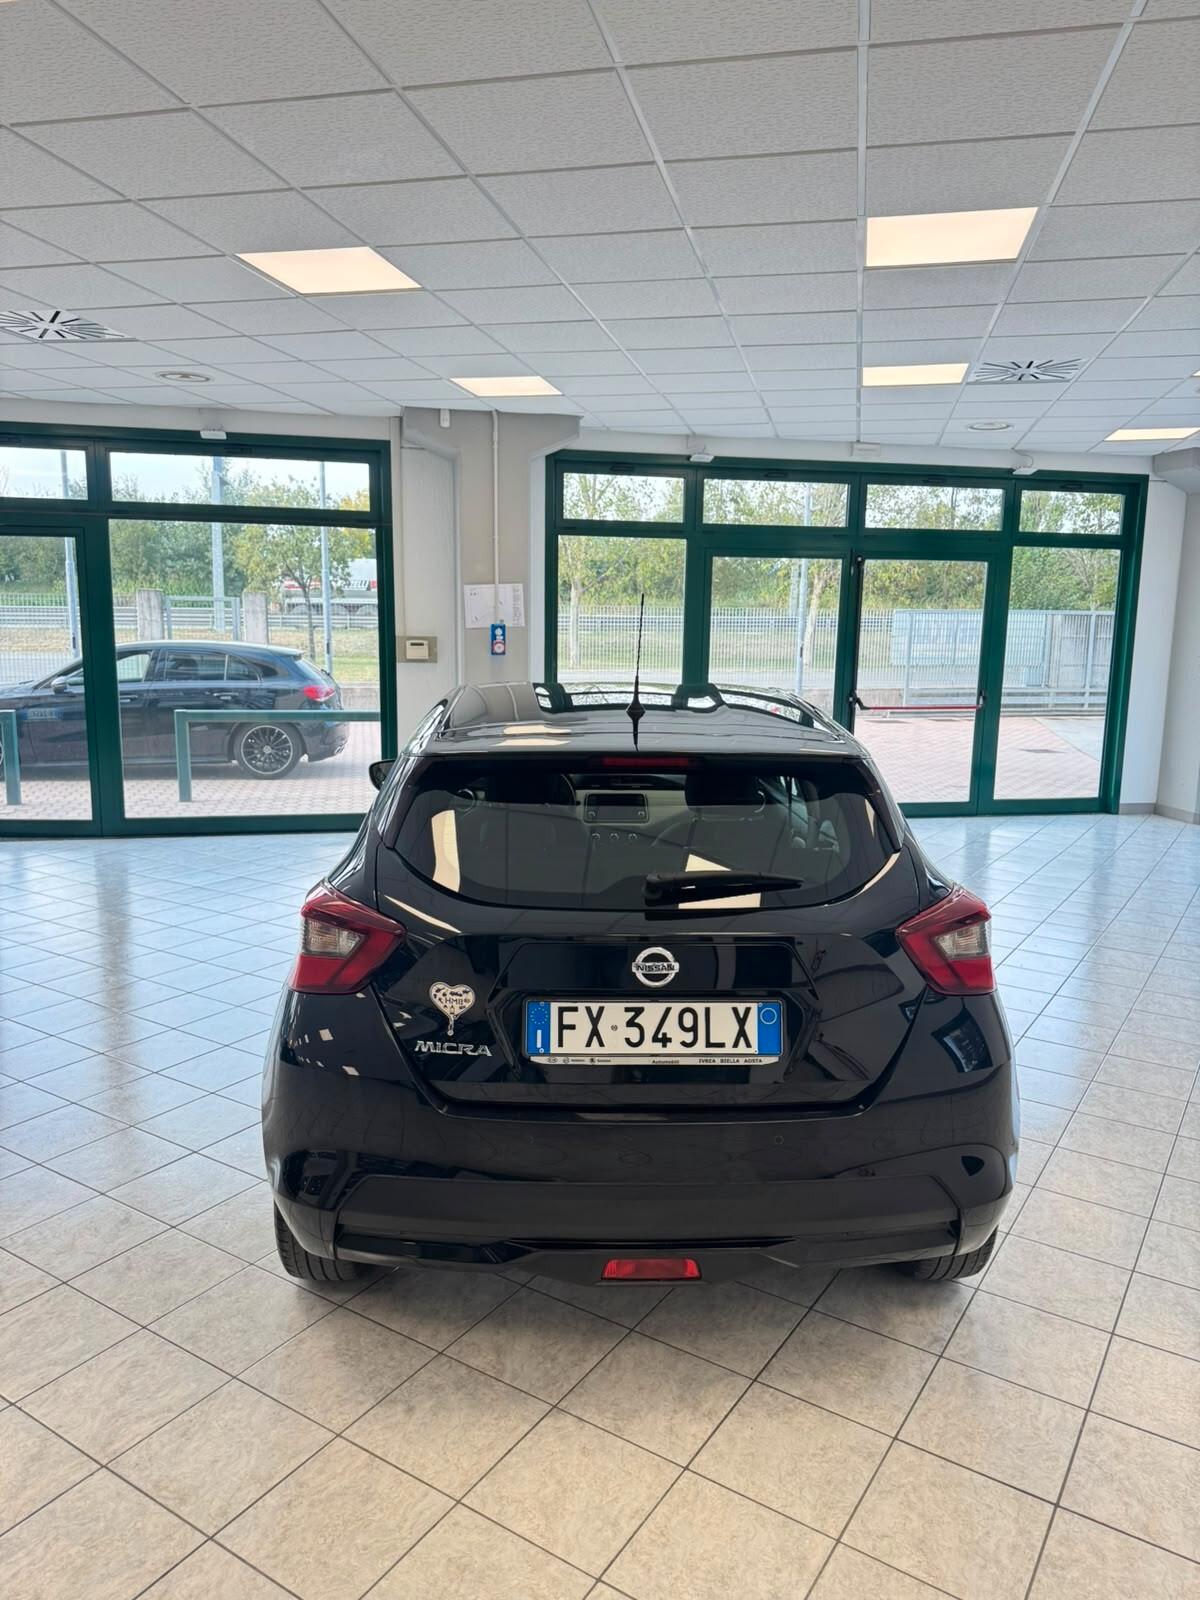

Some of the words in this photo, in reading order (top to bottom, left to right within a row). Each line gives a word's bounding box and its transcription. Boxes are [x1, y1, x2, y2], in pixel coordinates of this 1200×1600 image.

[635, 962, 675, 973] NISSAN
[557, 1005, 605, 1048] FX
[623, 1006, 752, 1049] 349LX
[414, 1040, 492, 1057] MICRA
